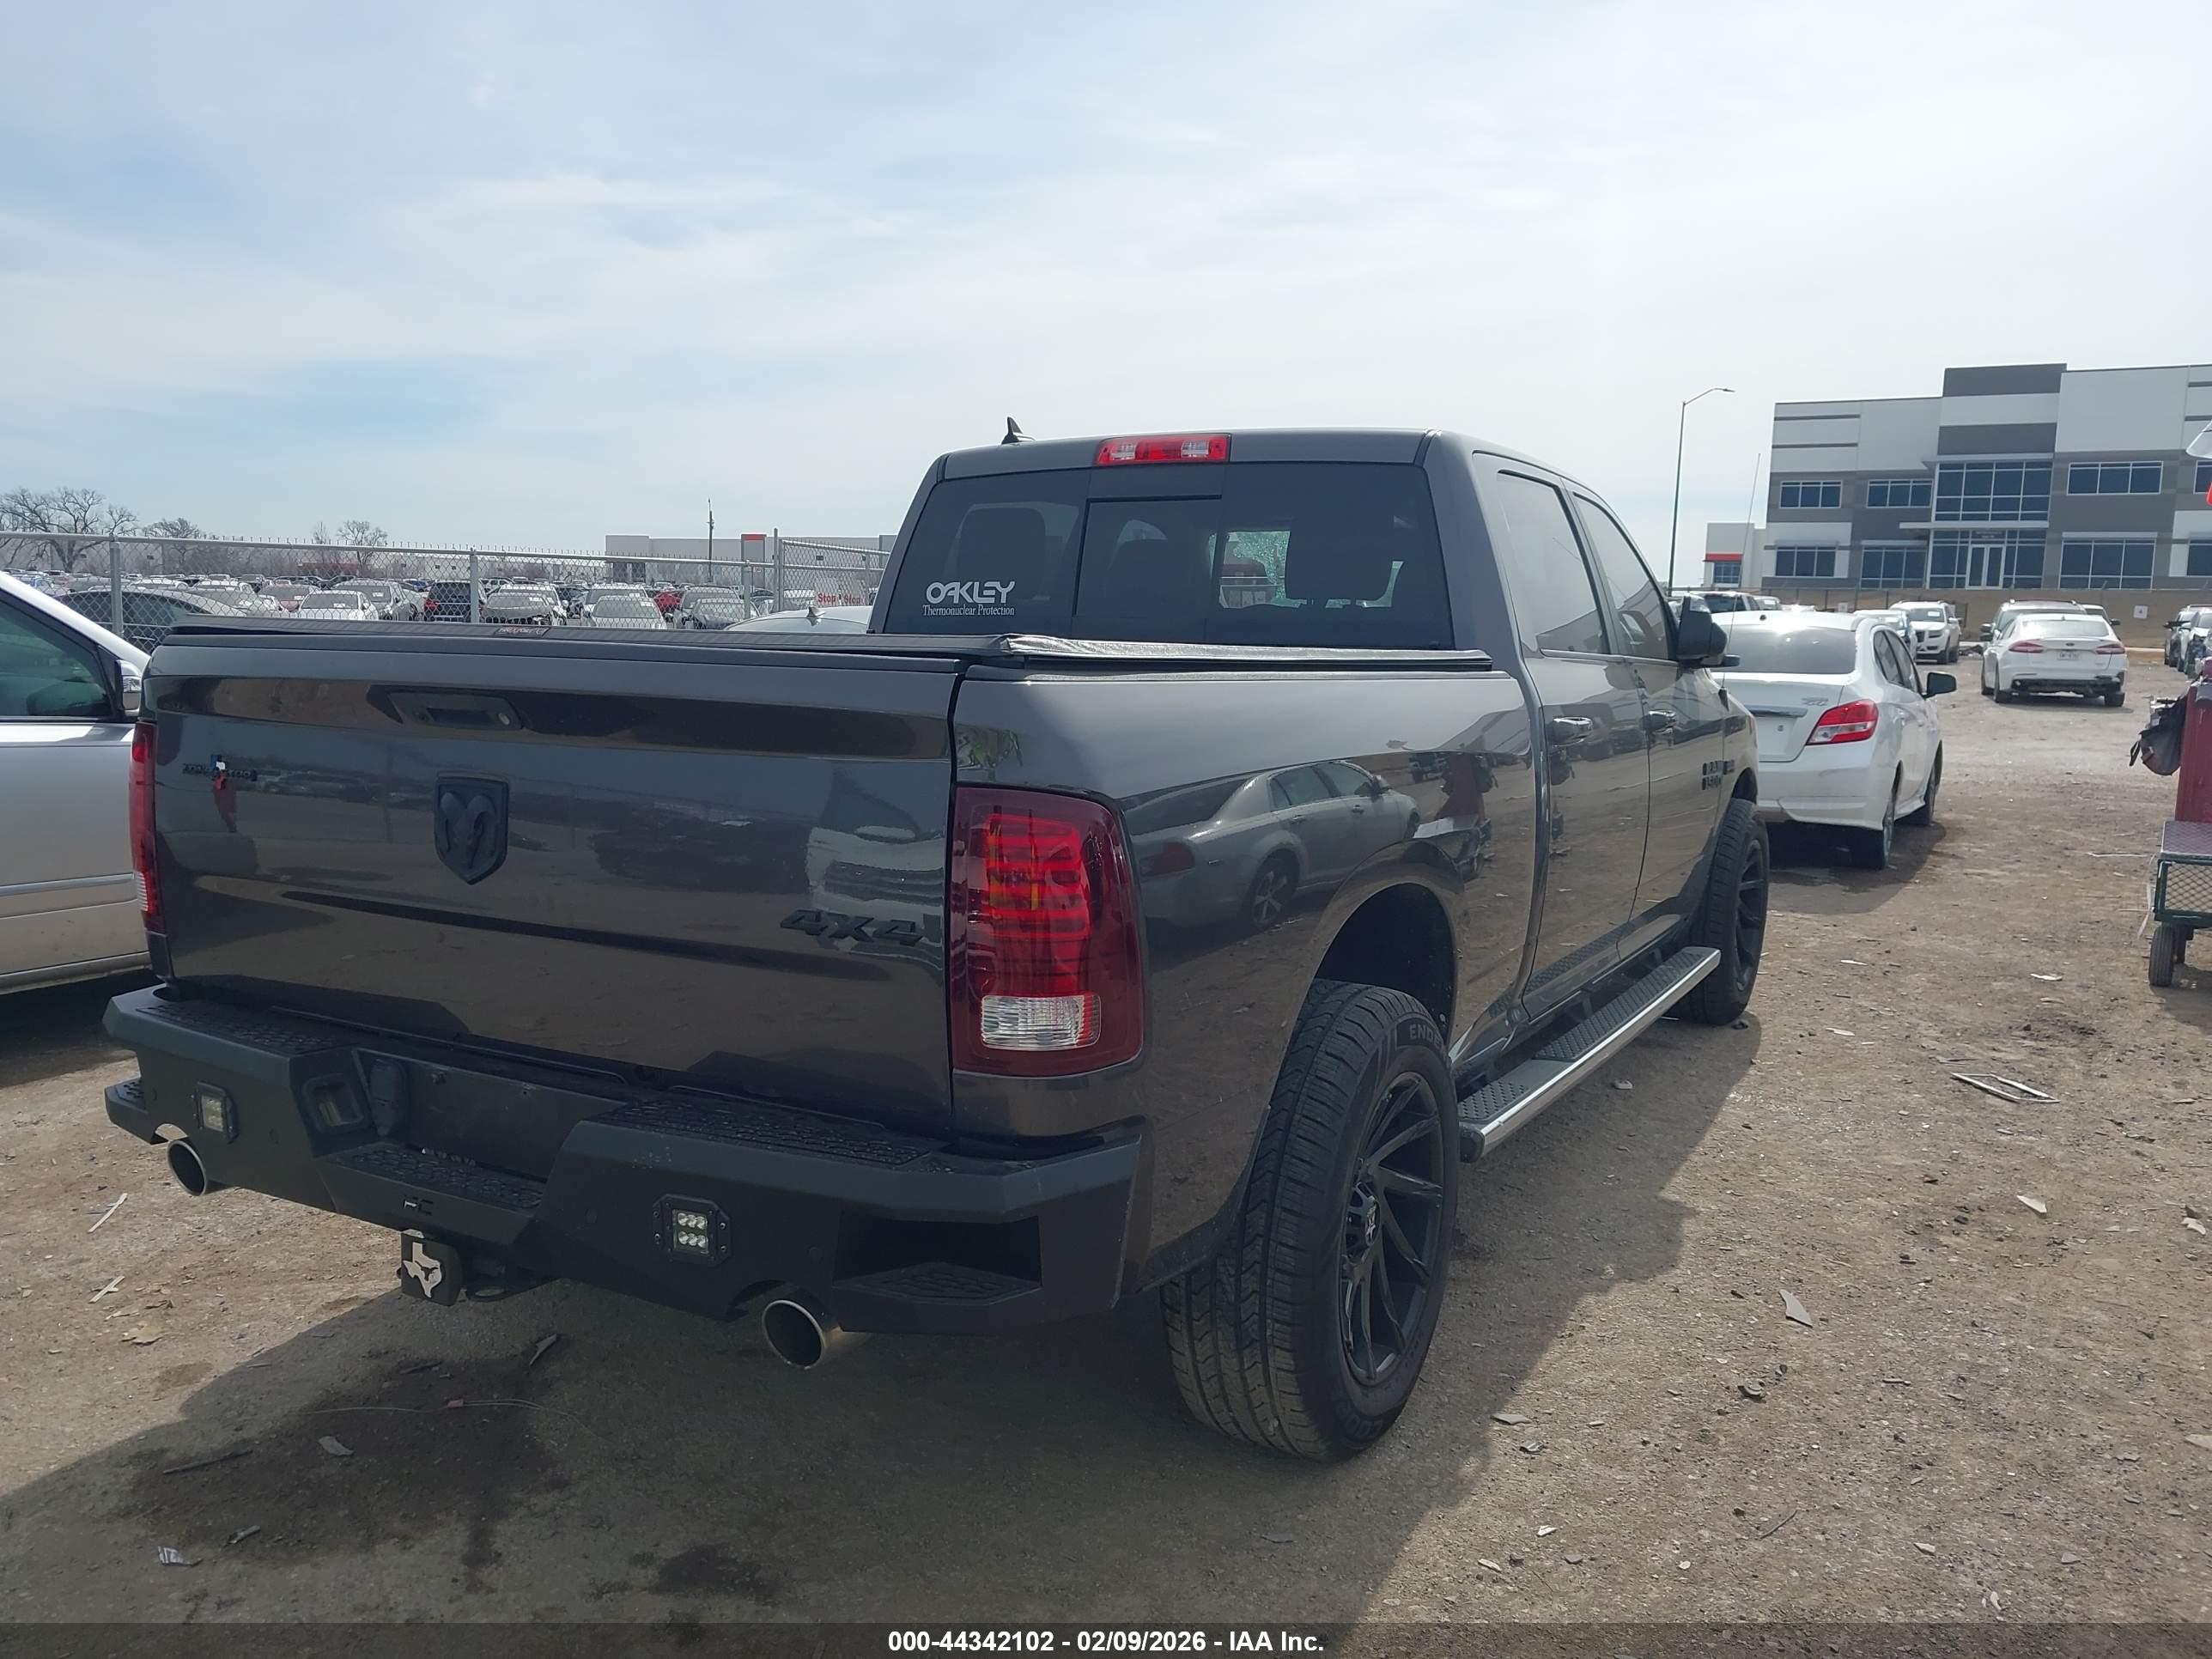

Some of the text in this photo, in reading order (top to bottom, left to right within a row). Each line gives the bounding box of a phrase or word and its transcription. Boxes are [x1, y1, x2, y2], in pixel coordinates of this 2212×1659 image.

[817, 592, 836, 605] Stop
[926, 580, 1016, 604] OAKLEY
[922, 604, 1015, 616] Thermonuclear Protection
